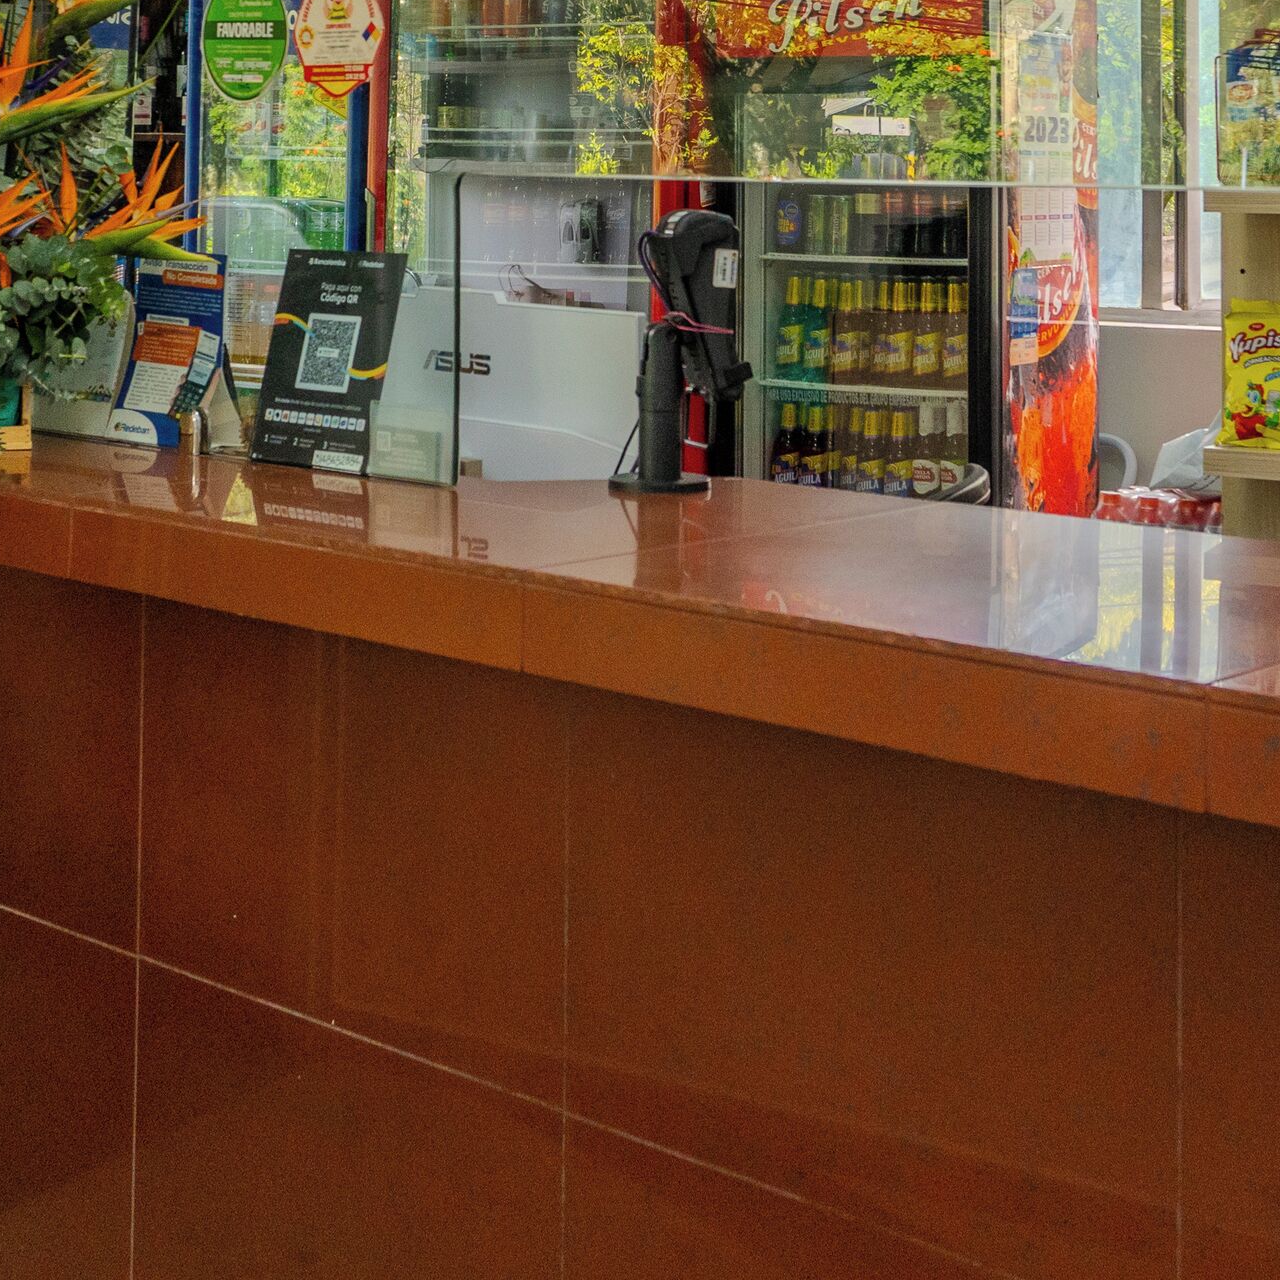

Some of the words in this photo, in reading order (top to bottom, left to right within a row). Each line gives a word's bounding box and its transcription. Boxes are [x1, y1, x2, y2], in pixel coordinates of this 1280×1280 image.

[216, 22, 274, 38] FAVORABLE
[1024, 116, 1070, 144] 2023
[320, 292, 346, 305] Código
[346, 294, 359, 303] QR
[423, 349, 491, 376] ASUS
